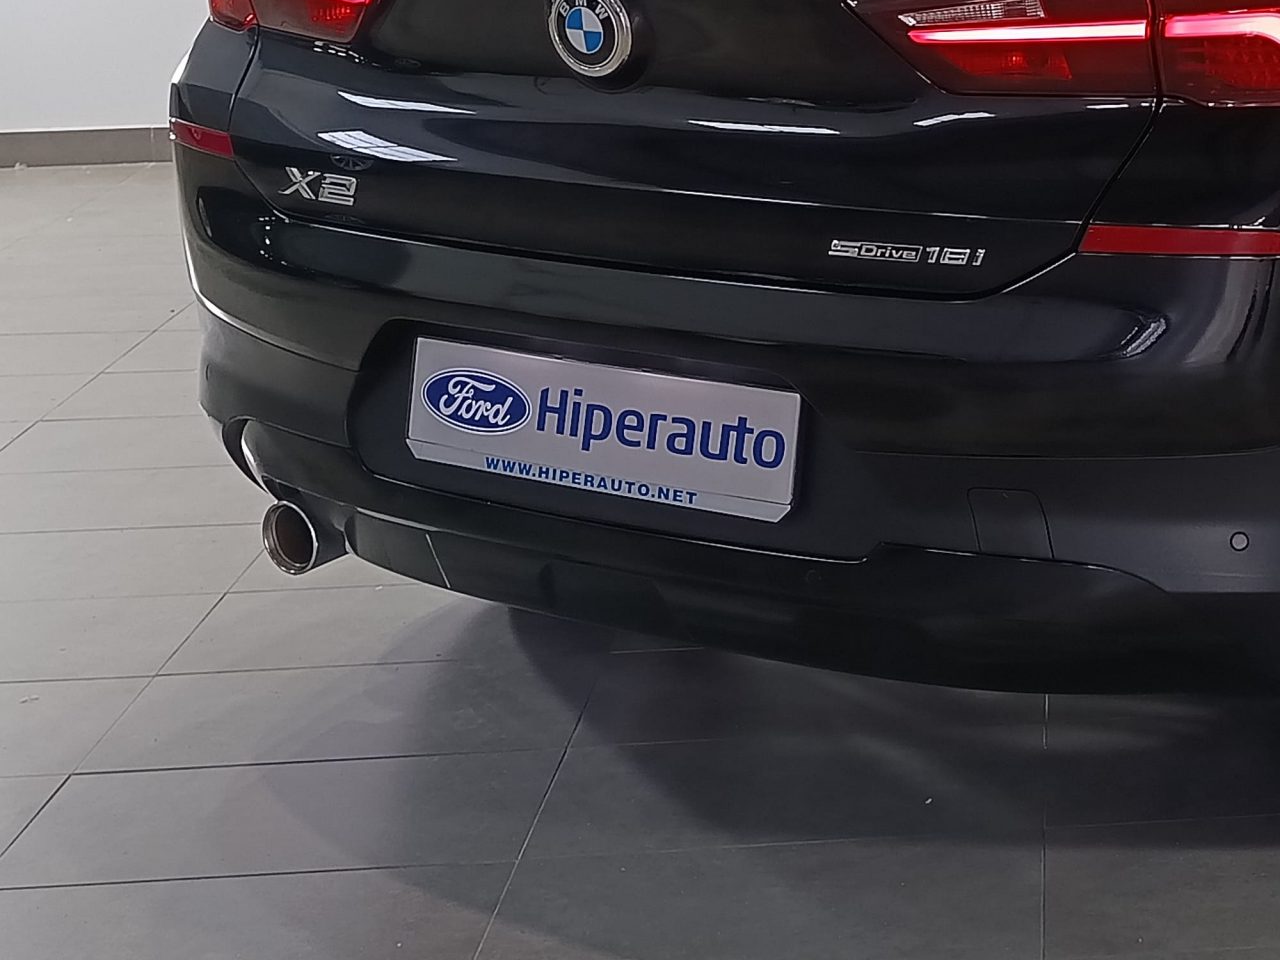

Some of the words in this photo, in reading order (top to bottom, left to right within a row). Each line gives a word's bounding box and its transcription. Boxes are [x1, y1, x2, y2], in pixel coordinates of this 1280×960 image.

[278, 166, 357, 206] X2
[438, 376, 514, 427] Ford
[535, 386, 786, 469] Hiperauto
[484, 456, 699, 506] WWW.HIPERAUTO.NET
